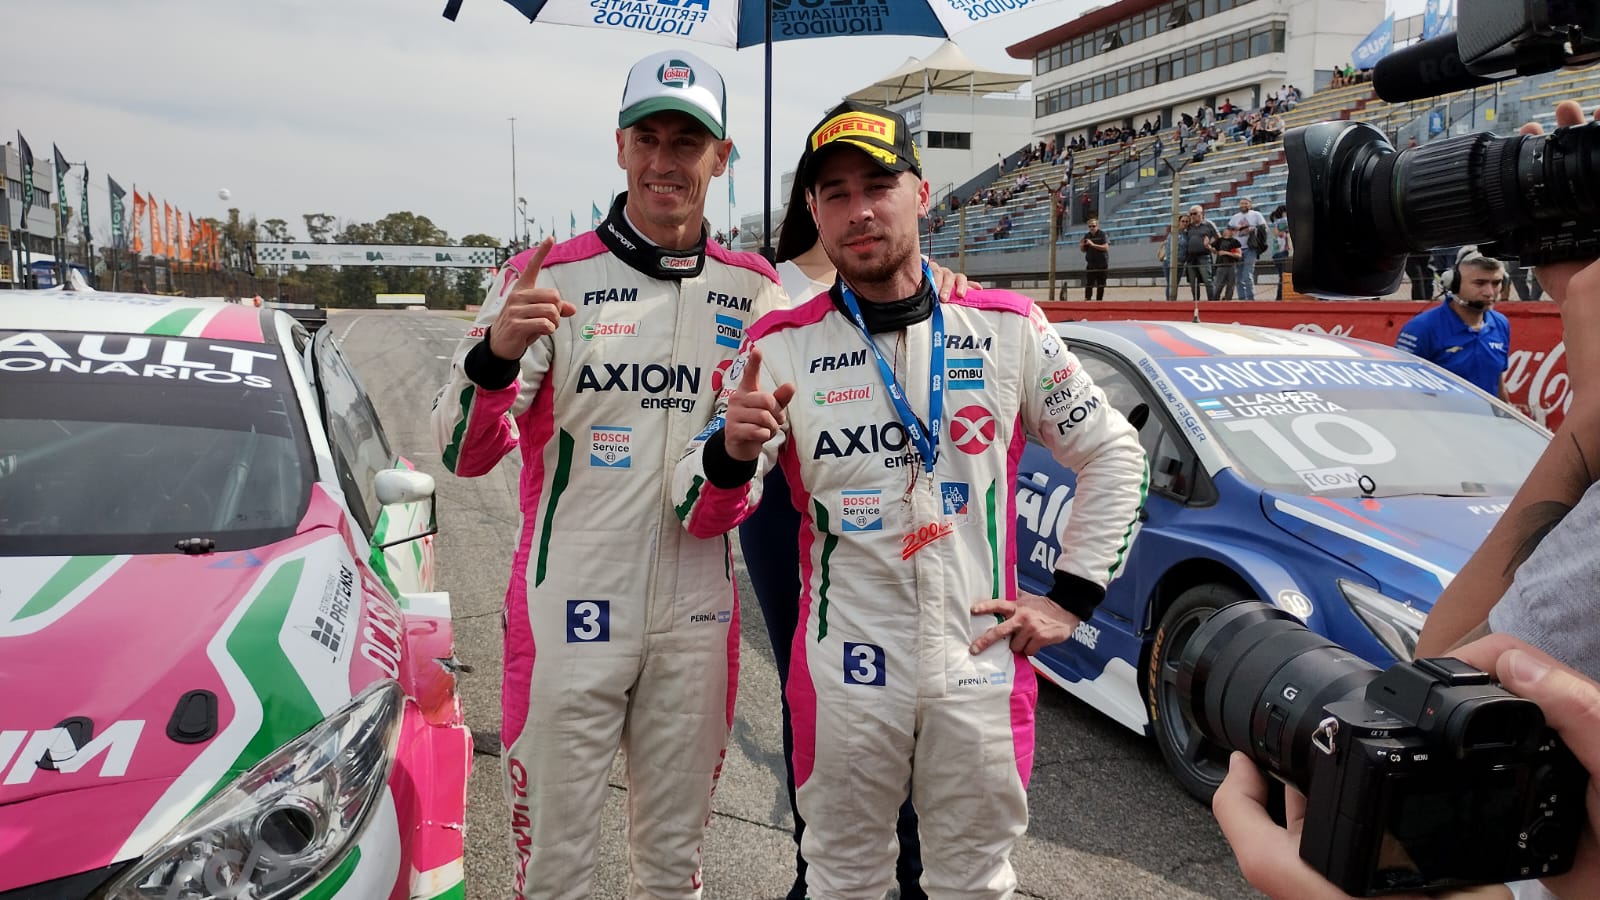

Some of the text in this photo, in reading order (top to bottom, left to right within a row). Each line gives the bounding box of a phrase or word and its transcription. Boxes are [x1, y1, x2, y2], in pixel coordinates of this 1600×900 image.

[664, 67, 689, 81] Castrol
[817, 116, 887, 148] PIRELLI
[292, 250, 310, 260] BA
[366, 251, 384, 261] BA
[435, 252, 453, 262] BA
[670, 258, 696, 268] Castrol
[707, 291, 752, 312] FRAM
[593, 322, 636, 336] Castrol
[809, 350, 867, 373] FRAM
[576, 363, 701, 394] AXION
[827, 386, 870, 404] Castrol
[1223, 390, 1323, 409] LLAVER
[641, 396, 696, 413] energy
[1236, 400, 1348, 419] URRUTIA
[593, 432, 630, 443] BOSCH
[1224, 413, 1397, 471] 10
[592, 442, 630, 453] Service
[843, 496, 880, 506] BOSCH
[843, 506, 880, 516] Service
[573, 601, 601, 641] 3
[690, 612, 717, 623] PERNÍA
[850, 644, 877, 683] 3
[1283, 687, 1298, 701] G
[1390, 754, 1401, 762] C3
